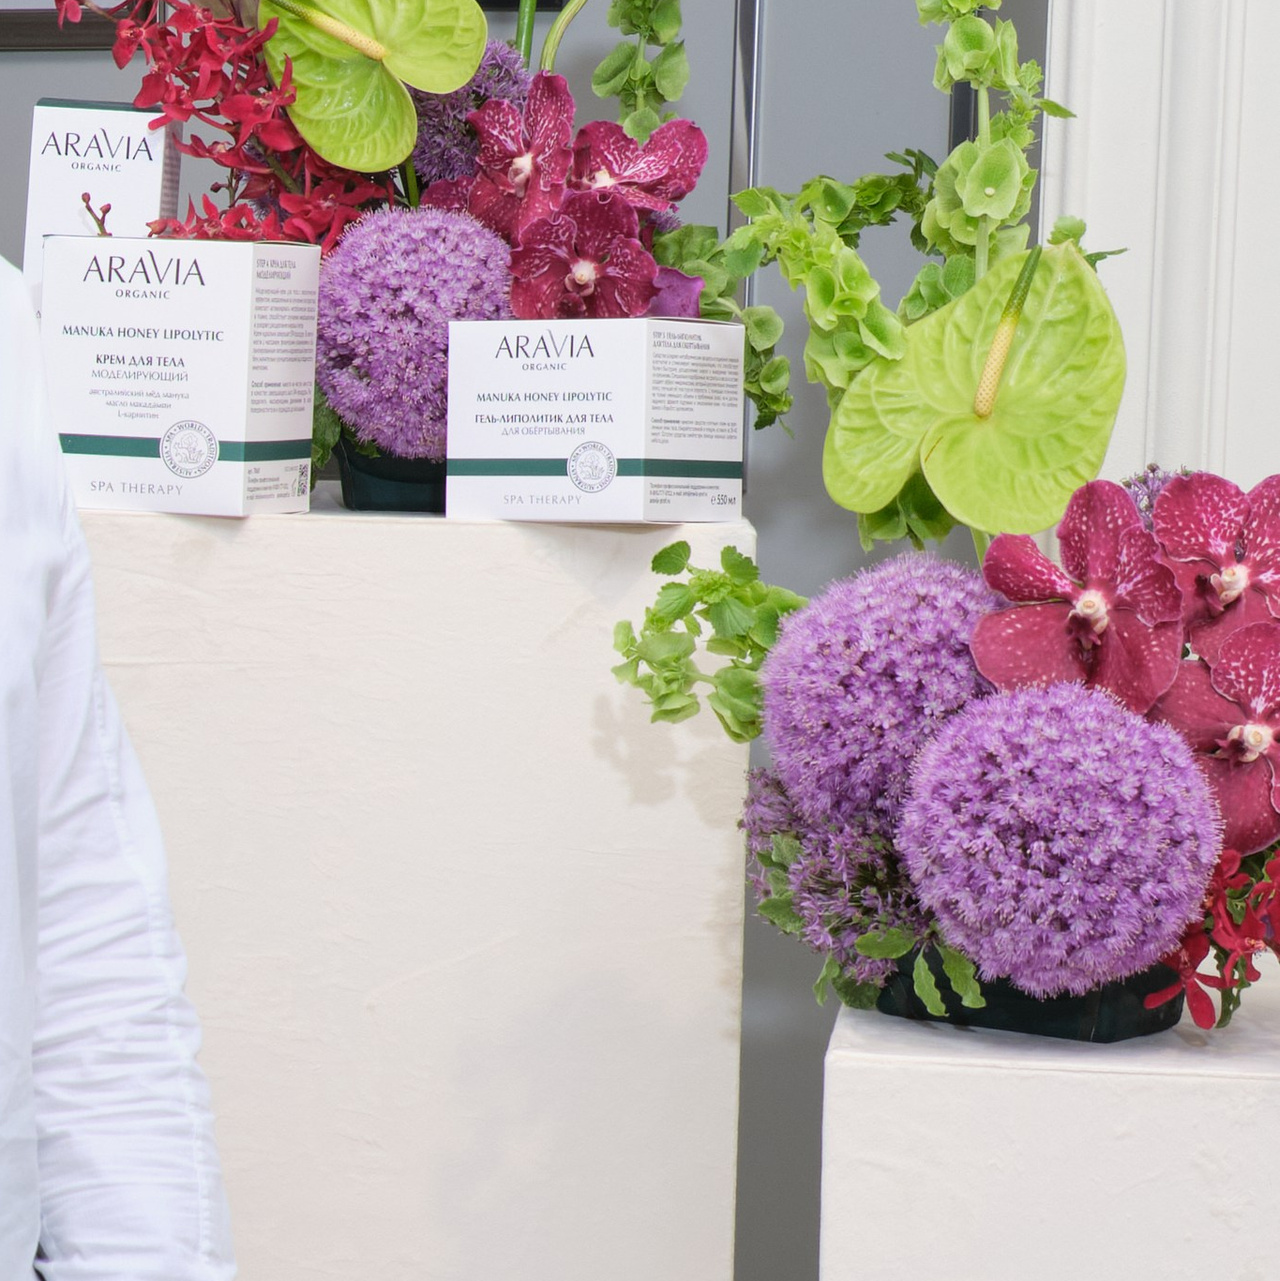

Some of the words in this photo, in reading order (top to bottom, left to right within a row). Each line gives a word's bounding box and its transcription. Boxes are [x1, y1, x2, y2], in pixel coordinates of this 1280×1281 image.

[41, 128, 153, 161] ARAVIA
[71, 162, 122, 173] ORGANIC
[83, 250, 205, 286] ARAVIA
[115, 289, 171, 300] ORGANIC
[62, 325, 114, 337] MANUKA
[117, 327, 160, 339] HONEY
[163, 329, 224, 341] LIPOLYTIC
[495, 329, 595, 359] ARAVIA
[96, 354, 125, 365] КРЕМ
[128, 356, 153, 367] ДЛЯ
[156, 356, 185, 368] ТЕЛА
[521, 362, 568, 371] ORGANIC
[91, 369, 188, 382] МОДЕЛИРУЮЩИЙ
[88, 388, 144, 398] австралийский
[476, 392, 521, 402] MANUKA
[523, 392, 560, 402] HONEY
[562, 391, 613, 402] LIPOLYTIC
[475, 414, 563, 424] ГЕЛЬ-ЛИПОЛИТИК
[565, 414, 587, 424] ДЛЯ
[590, 414, 614, 423] ТЕЛА
[177, 422, 204, 432] WORLD
[501, 427, 520, 436] ДЛЯ
[90, 480, 114, 493] SPA
[120, 482, 183, 495] THERAPY
[503, 495, 524, 505] SPA
[529, 495, 582, 505] THERAPY
[717, 494, 727, 505] 550
